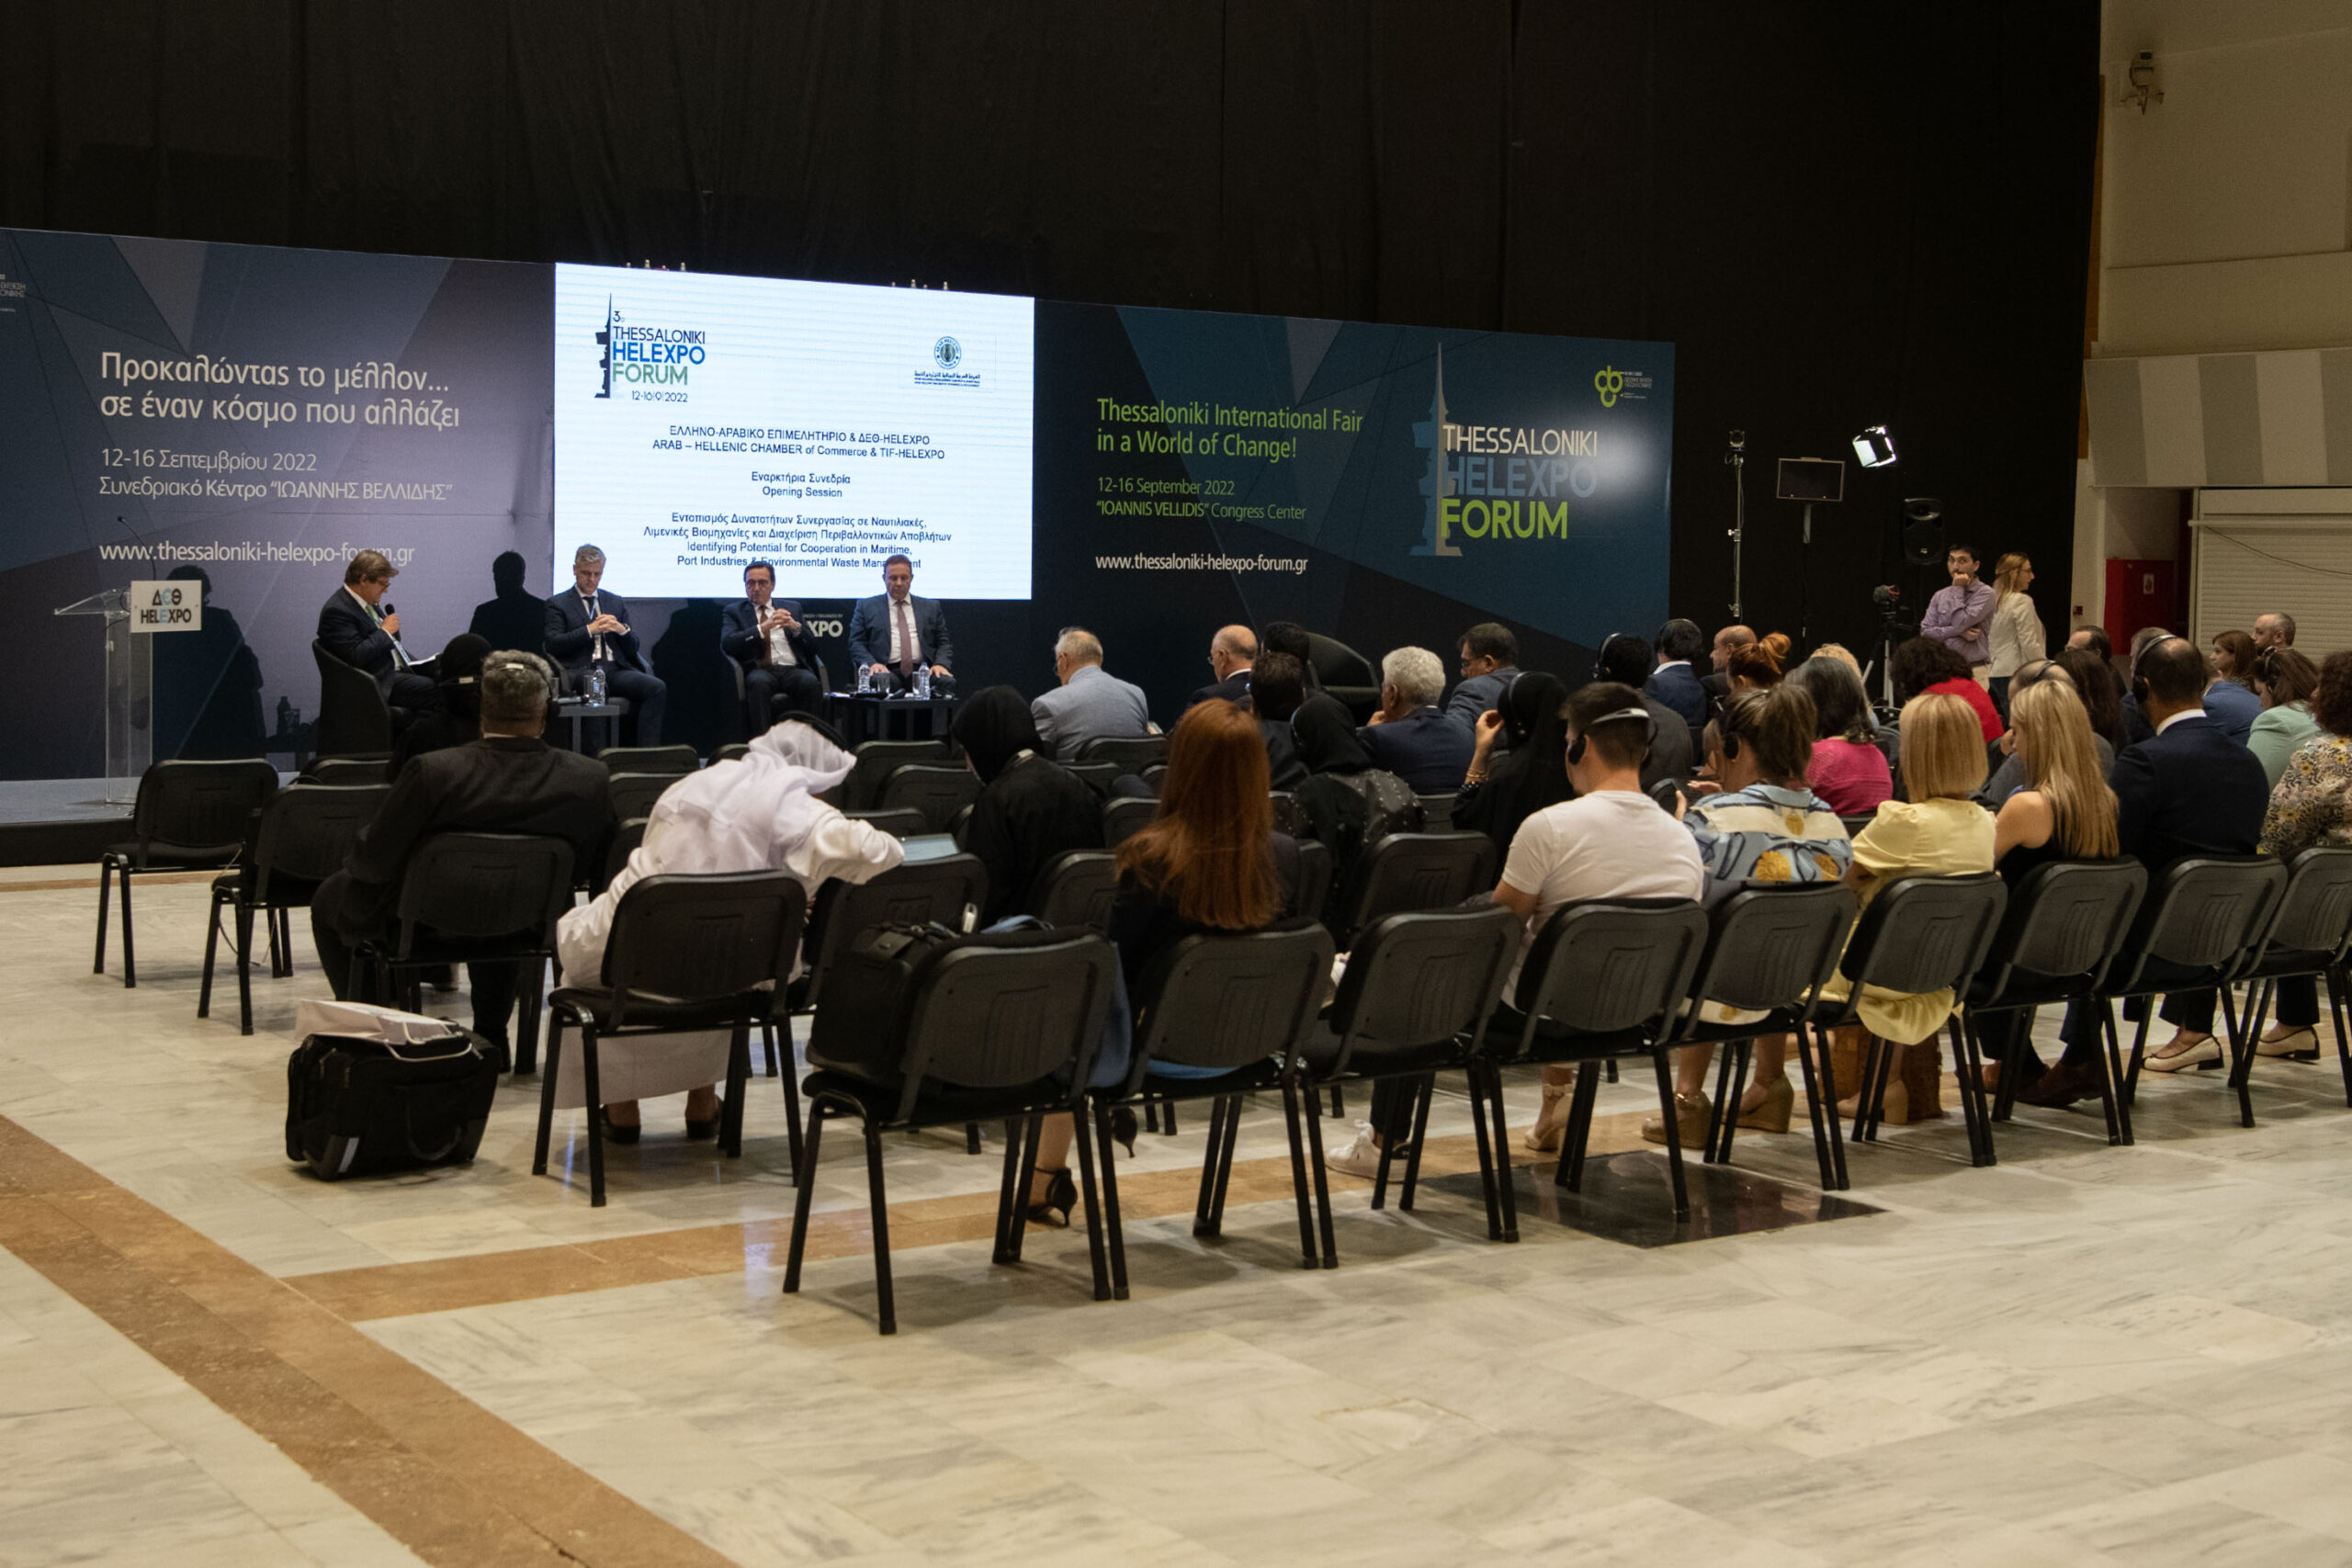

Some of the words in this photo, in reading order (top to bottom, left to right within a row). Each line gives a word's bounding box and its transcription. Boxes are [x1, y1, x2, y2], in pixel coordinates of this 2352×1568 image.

[613, 325, 706, 344] THESSALONIKI
[612, 341, 706, 365] HELEXPO
[101, 351, 290, 387] Προκαλώντας
[298, 367, 325, 387] το
[612, 363, 688, 386] FORUM
[100, 396, 133, 416] σε
[141, 389, 204, 419] έναν
[212, 393, 297, 428] κόσμο
[307, 402, 356, 423] που
[365, 397, 459, 432] αλλάζει
[1096, 397, 1209, 424] Thessaloniki
[1215, 403, 1328, 430] International
[1333, 410, 1363, 432] Fair
[670, 425, 764, 439] ΕΛΛΗΝΟ-ΑΡΑΒΙΚΟ
[767, 429, 846, 443] ΕΠΙΜΕΛΗΤΗΡΙΟ
[849, 433, 856, 442] &
[858, 434, 930, 446] ΔΕΘ-HELEXPO
[1097, 427, 1114, 451] in
[1120, 434, 1131, 452] a
[1136, 430, 1193, 454] World
[1198, 432, 1219, 455] of
[1223, 433, 1296, 463] Change!
[1442, 424, 1598, 457] THESSALONIKI
[102, 448, 154, 467] 12-16
[159, 450, 267, 473] Σεπτεμβρίου
[272, 453, 317, 471] 2022
[652, 439, 683, 450] ARAB
[695, 441, 748, 453] HELLENIC
[750, 443, 803, 455] CHAMBER
[806, 446, 815, 455] of
[817, 445, 867, 457] Commerce
[870, 446, 877, 457] &
[879, 447, 945, 459] TIF-HELEXPO
[752, 471, 806, 484] Εναρκτήρια
[808, 473, 851, 485] Συνεδρία
[1098, 477, 1134, 492] 12-16
[1136, 478, 1201, 497] September
[1204, 479, 1235, 496] 2022
[1442, 455, 1597, 498] HELEXPO
[99, 476, 203, 500] Συνεδριακό
[206, 478, 267, 502] Κέντρο
[762, 486, 802, 499] Opening
[805, 487, 842, 498] Session
[672, 512, 729, 525] Εντοπισμός
[731, 513, 793, 527] Δυνατοτήτων
[797, 514, 854, 527] Συνεργασίας
[857, 518, 868, 526] σε
[1211, 502, 1265, 522] Congress
[1267, 503, 1306, 520] Center
[1441, 498, 1567, 539] FORUM
[643, 526, 689, 539] Λιμενικές
[692, 527, 750, 539] Βιομηχανίες
[769, 528, 818, 541] Διαχείριση
[820, 529, 898, 541] Περιβαλλοντικών
[900, 531, 952, 543] Αποβλήτων
[99, 540, 415, 567] www.thessaloniki-helexpo-fom.gr
[687, 541, 737, 553] Identifying
[740, 542, 782, 552] Potential
[785, 542, 797, 553] for
[800, 543, 856, 555] Cooperation
[860, 545, 868, 553] in
[870, 544, 912, 555] Maritime,
[677, 555, 697, 566] Port
[701, 556, 748, 566] Industries
[761, 557, 829, 567] Environmental
[831, 558, 859, 567] Waste
[1095, 552, 1308, 575] www.thessaloniki-helexpo-forum.gr
[141, 608, 192, 624] HELEXPO
